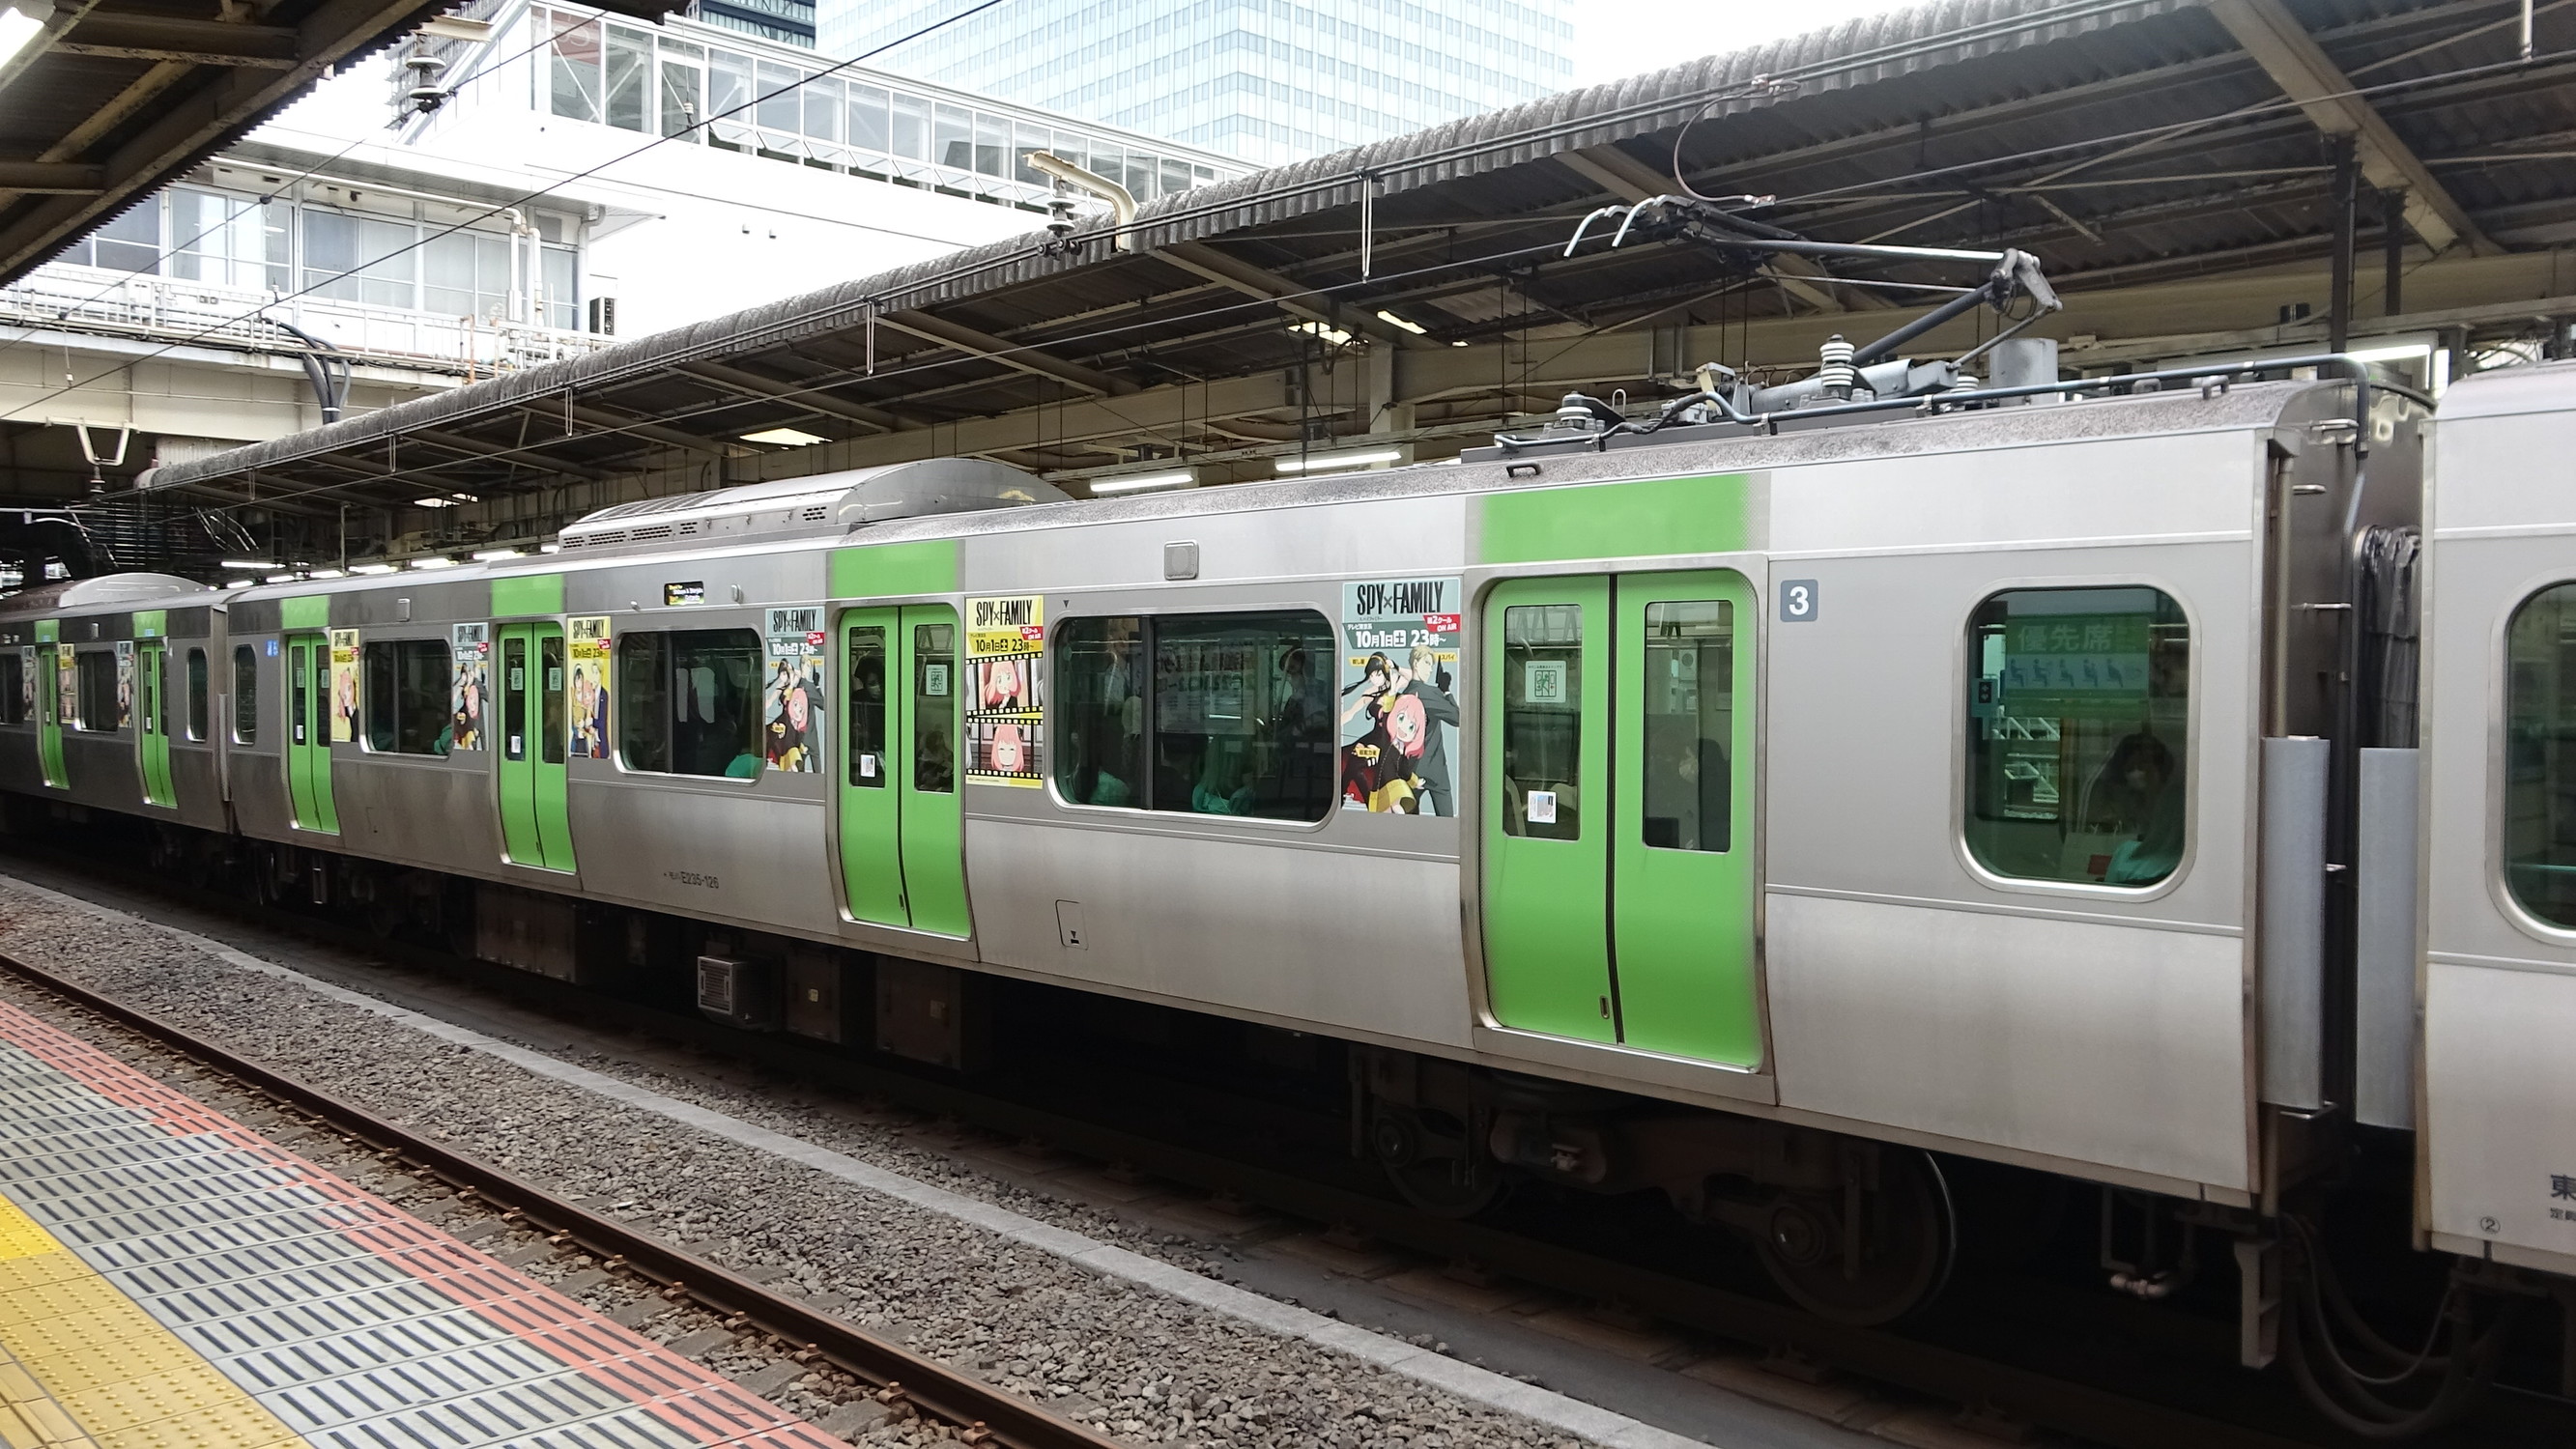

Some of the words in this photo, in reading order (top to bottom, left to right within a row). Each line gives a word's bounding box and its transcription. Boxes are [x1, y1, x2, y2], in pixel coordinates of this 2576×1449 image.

[1789, 585, 1810, 615] 3
[2018, 624, 2114, 652] 優先席
